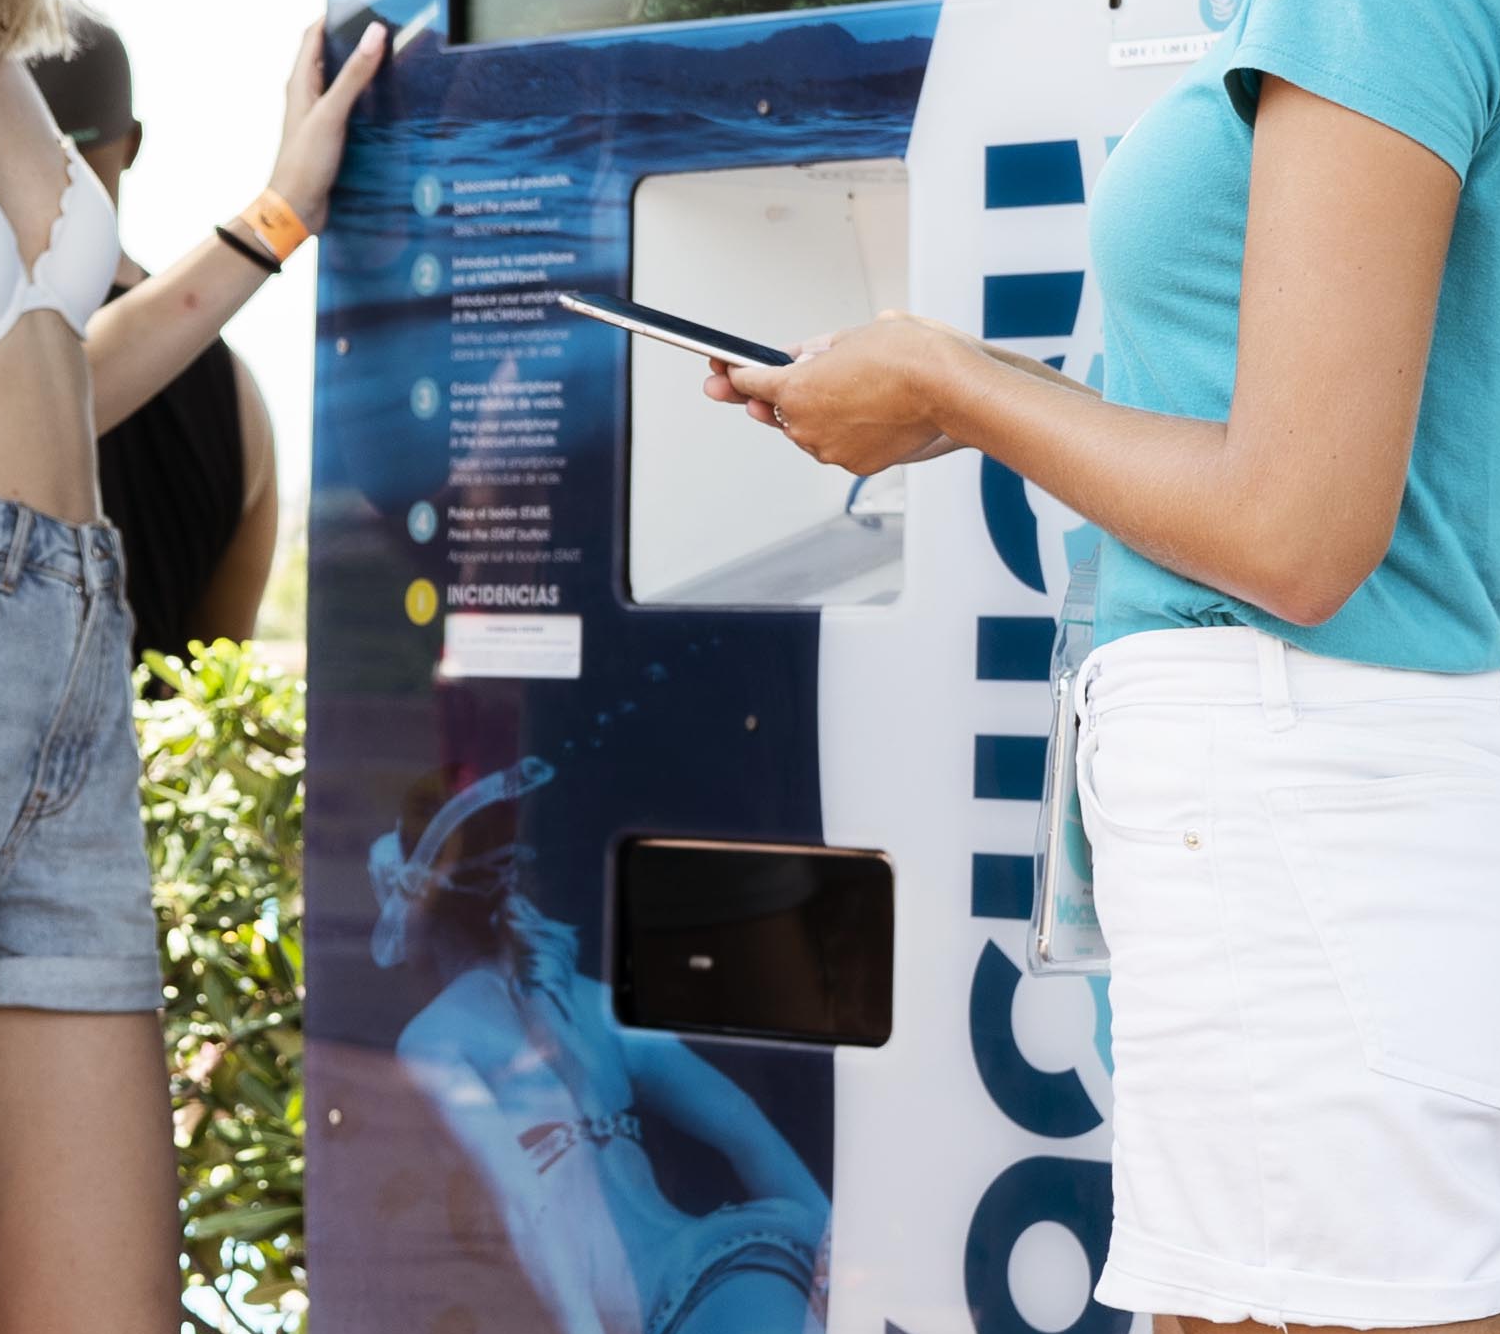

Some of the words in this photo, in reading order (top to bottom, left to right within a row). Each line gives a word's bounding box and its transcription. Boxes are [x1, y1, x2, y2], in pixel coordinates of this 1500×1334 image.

[421, 263, 433, 287] 2
[420, 387, 430, 410] 3
[415, 510, 427, 532] 4
[446, 584, 560, 607] INCIDENCIAS
